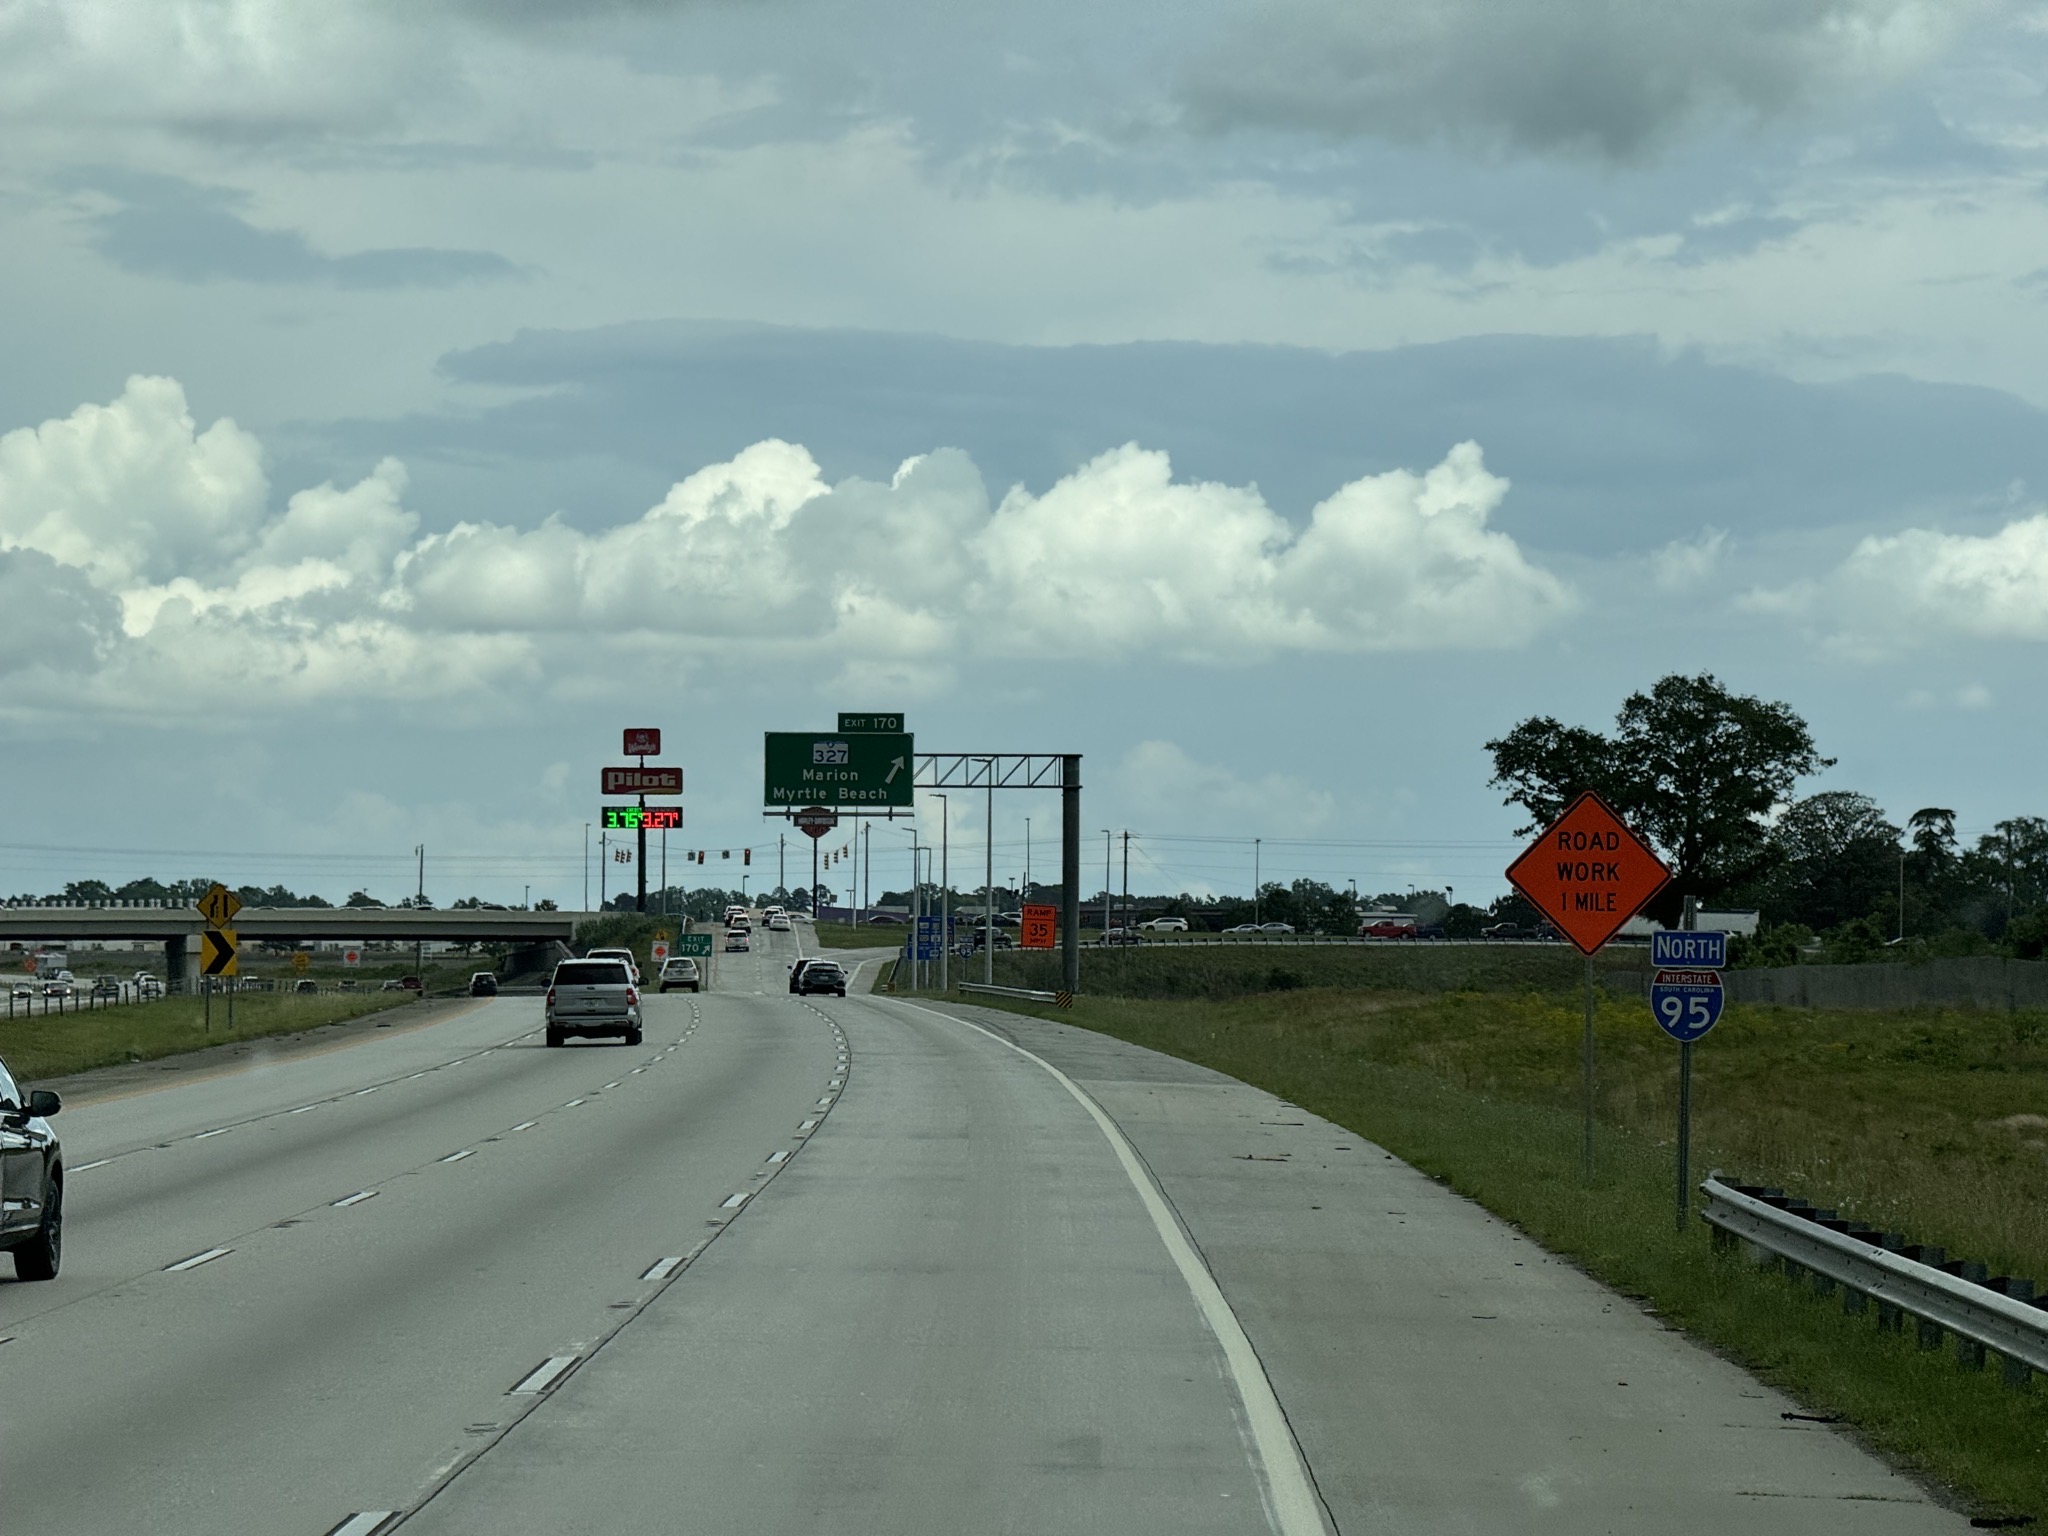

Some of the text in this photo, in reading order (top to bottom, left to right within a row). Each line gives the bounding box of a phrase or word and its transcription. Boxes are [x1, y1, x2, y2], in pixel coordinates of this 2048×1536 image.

[844, 717, 897, 729] EXIT 170
[814, 749, 848, 763] 327
[607, 772, 676, 790] Pilot
[802, 769, 859, 781] Marion
[773, 787, 888, 802] Myrtle Beach
[1557, 831, 1621, 851] ROAD
[1557, 862, 1621, 882] WORK
[1561, 892, 1617, 912] 1 MILE
[1027, 908, 1052, 917] RAMP
[1029, 923, 1048, 937] 35
[681, 943, 700, 952] 170
[960, 948, 972, 956] 95
[1656, 935, 1721, 960] NORTH
[1662, 973, 1713, 984] INTERSTATE
[1683, 986, 1715, 994] CAROLINA
[1661, 996, 1711, 1030] 95
